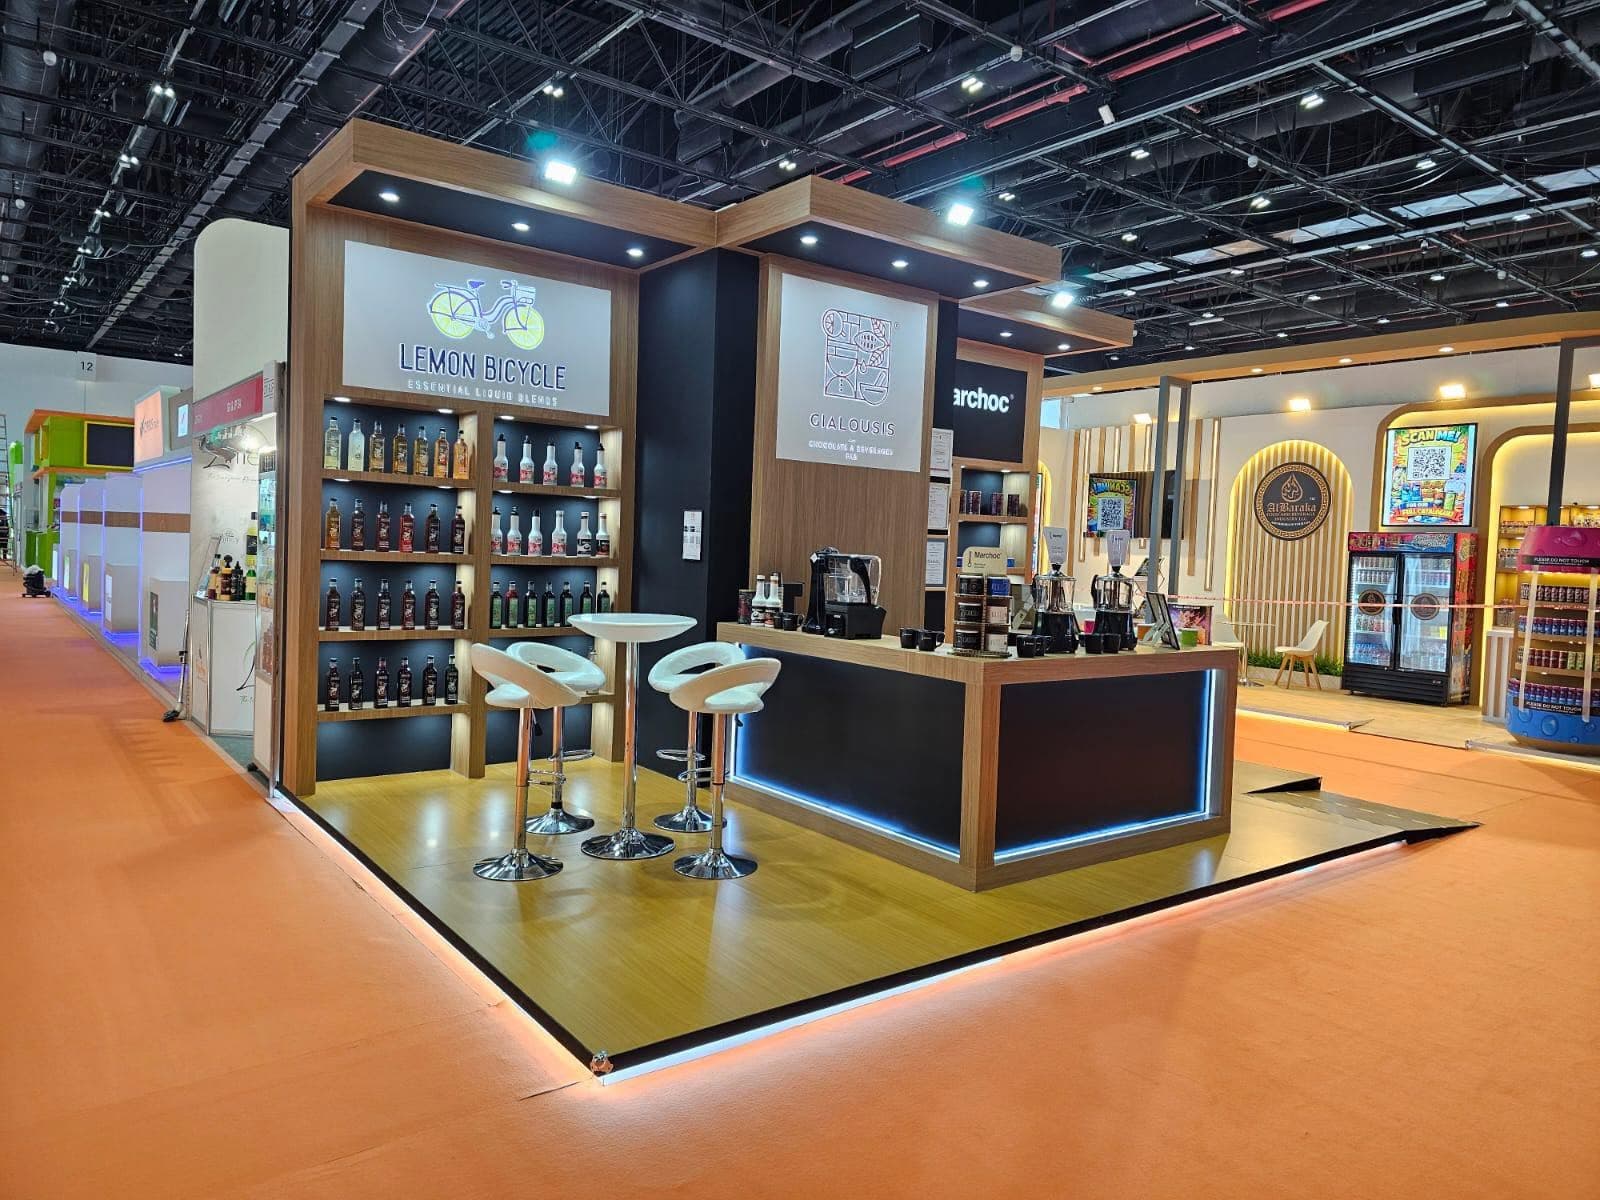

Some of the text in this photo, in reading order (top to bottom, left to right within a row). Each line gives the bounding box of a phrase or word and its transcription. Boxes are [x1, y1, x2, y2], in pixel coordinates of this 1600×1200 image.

[80, 361, 93, 371] 12
[400, 343, 566, 389] LEMON BICYCLE
[408, 379, 558, 407] ESSENTIAL LIQUID BLENDS
[809, 412, 896, 436] GIALOUSIS
[808, 440, 848, 451] CHOCOLATE
[1401, 430, 1461, 446] SCAN ME!
